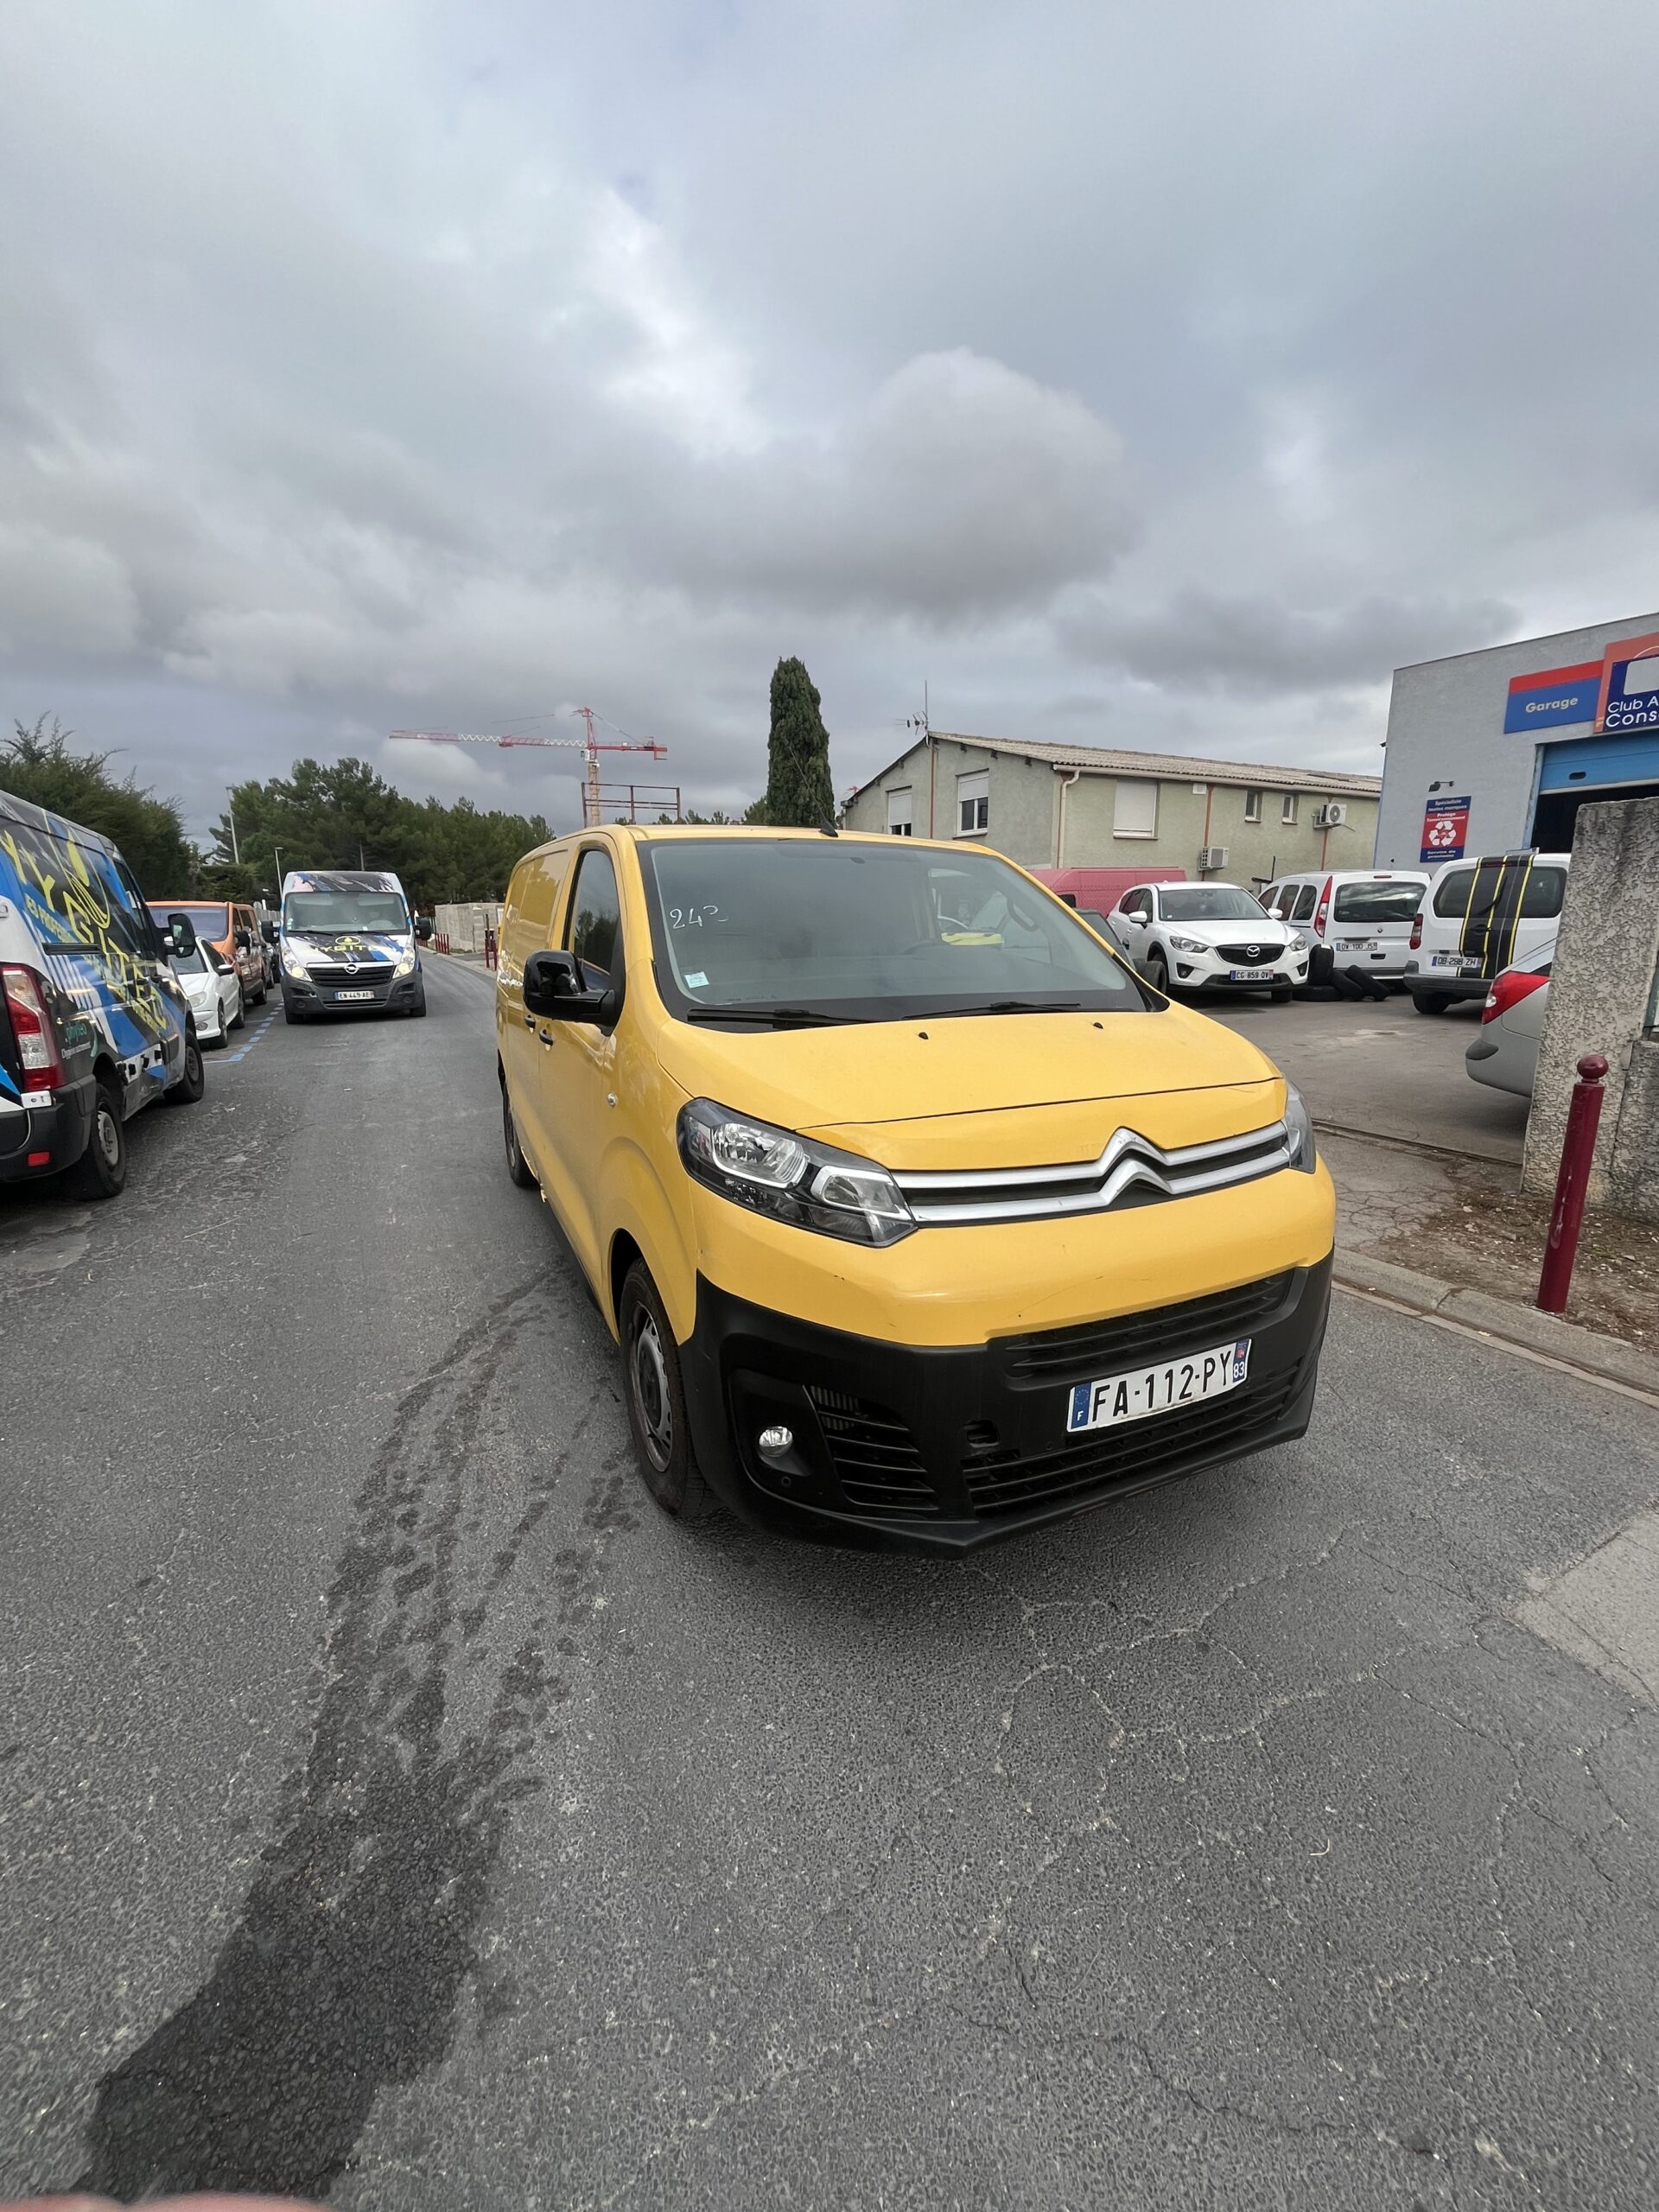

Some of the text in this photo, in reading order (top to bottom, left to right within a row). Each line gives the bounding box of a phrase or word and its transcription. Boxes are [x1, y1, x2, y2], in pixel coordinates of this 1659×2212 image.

[1525, 697, 1579, 713] Garage
[1607, 699, 1643, 714] Club
[1605, 710, 1659, 728] Cons
[1233, 1361, 1245, 1379] 83
[1091, 1351, 1232, 1422] FA-112-PY
[1077, 1410, 1084, 1421] F
